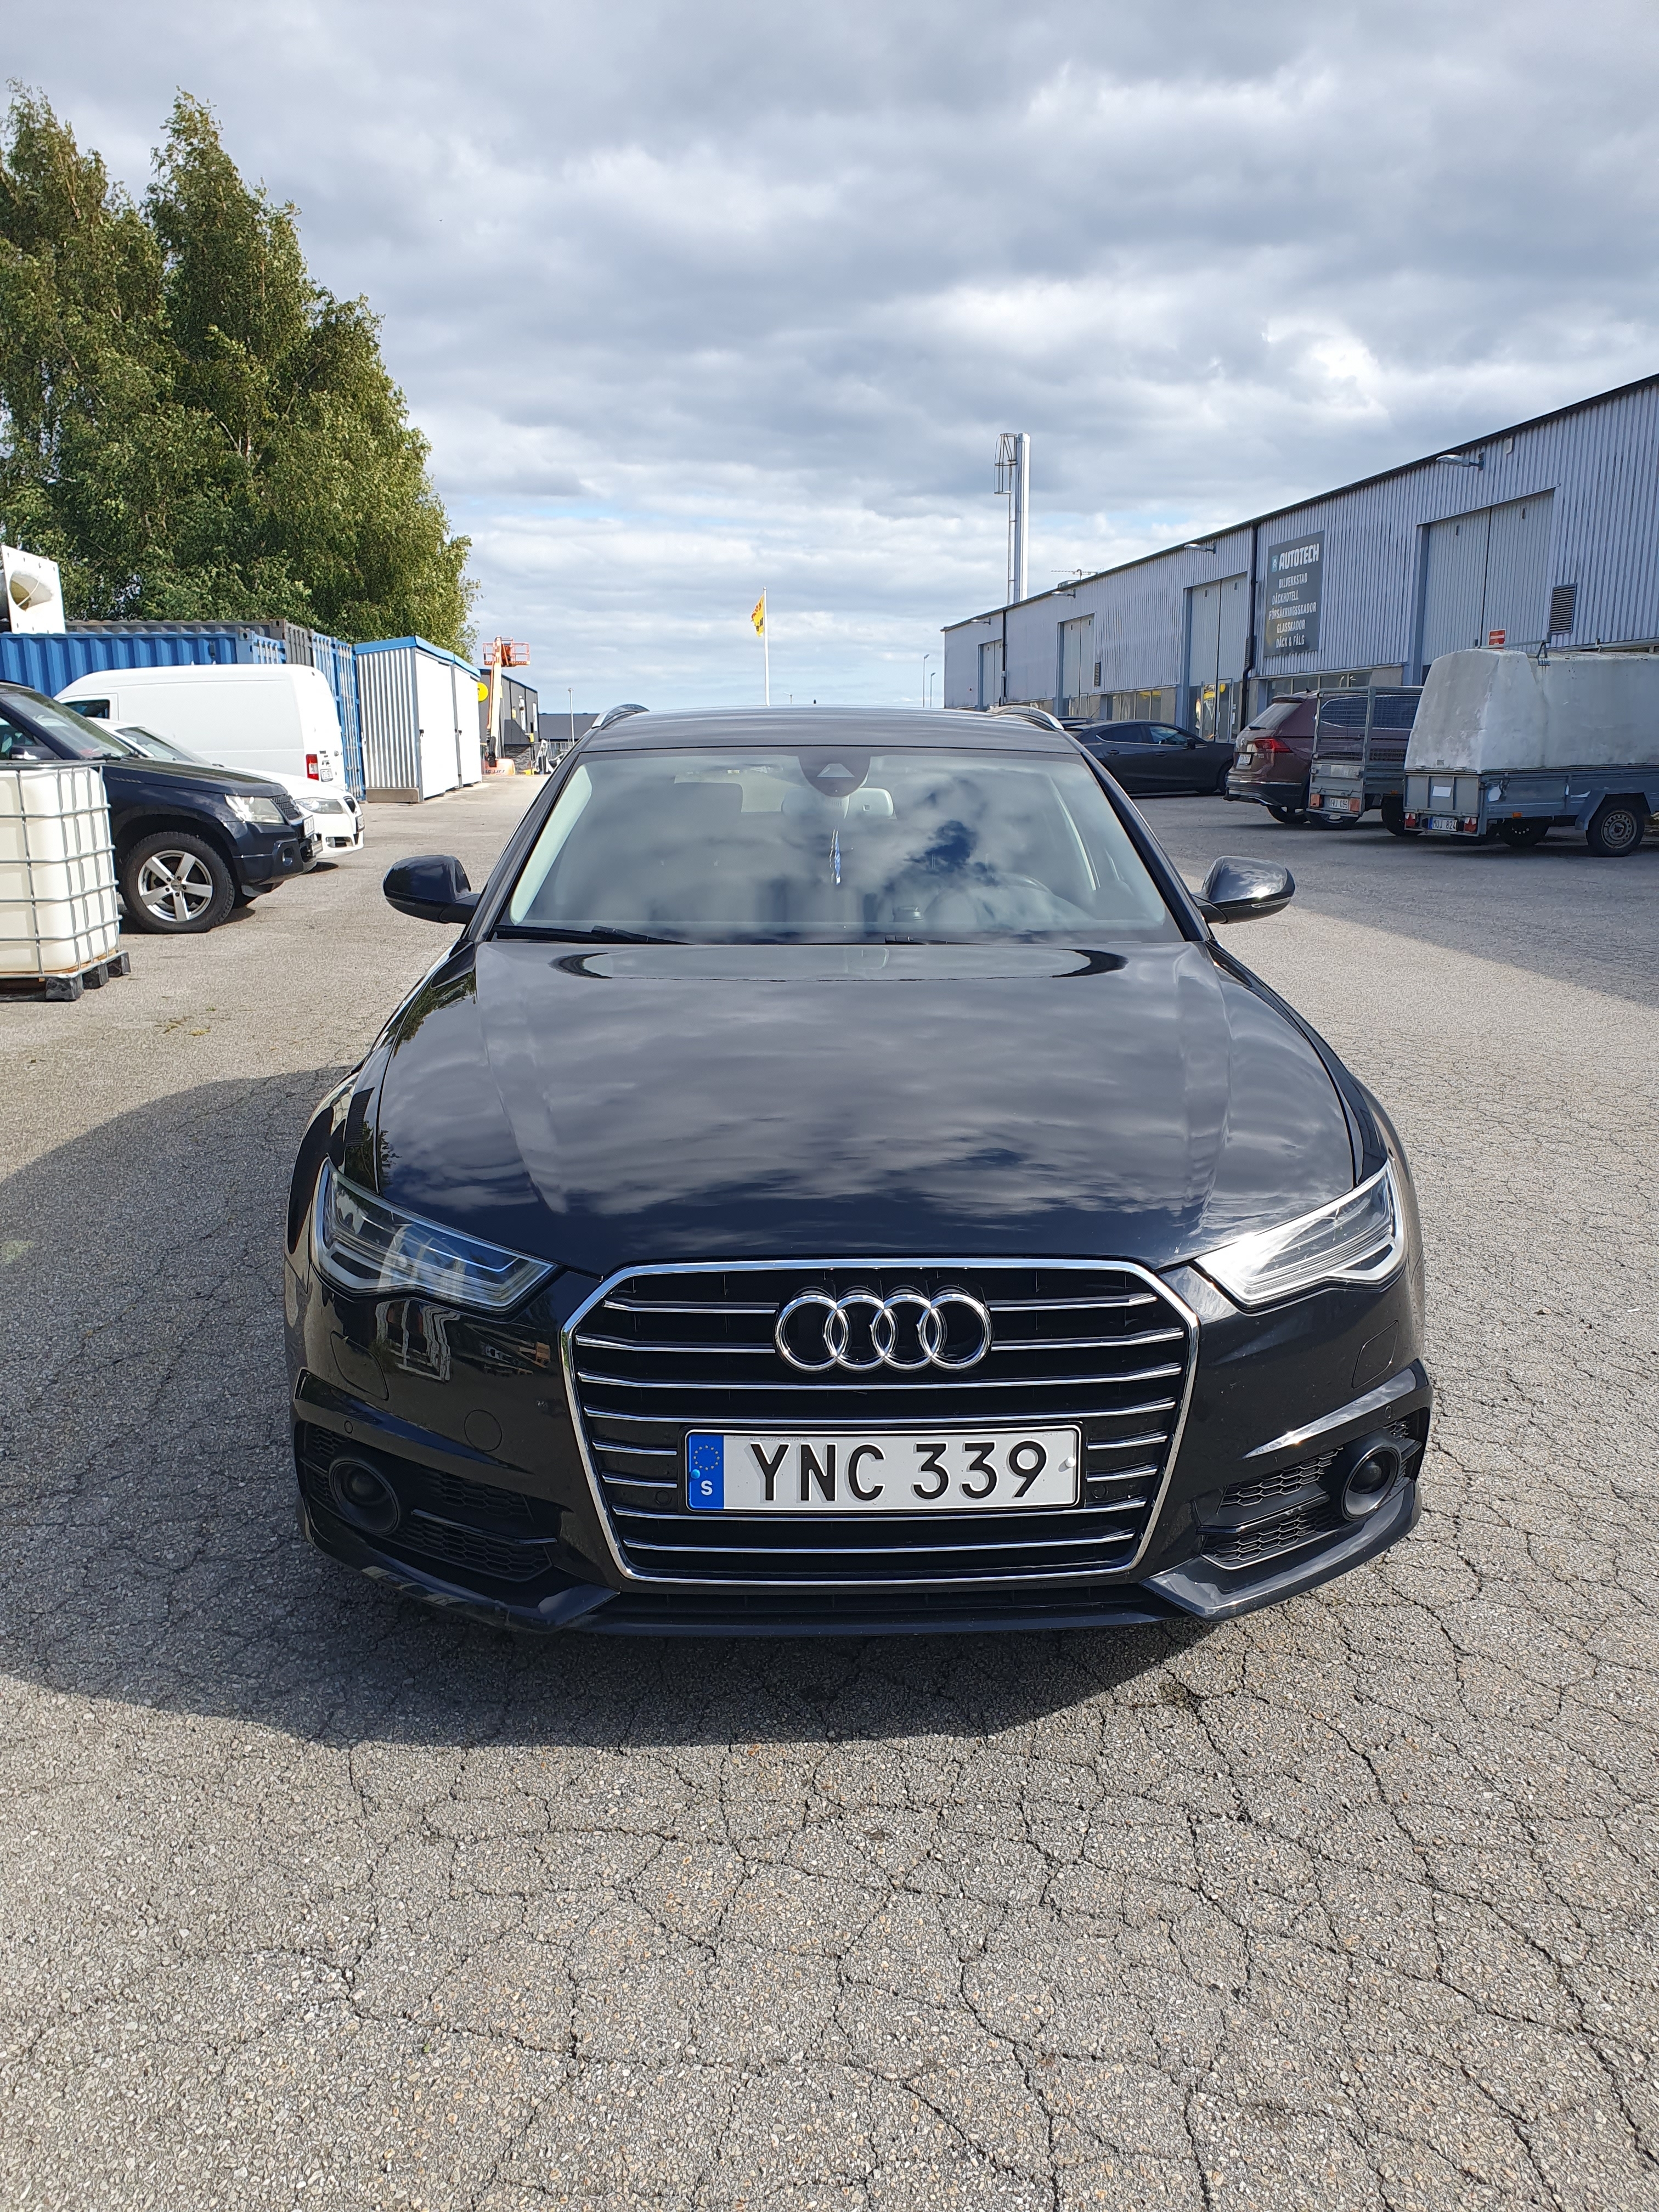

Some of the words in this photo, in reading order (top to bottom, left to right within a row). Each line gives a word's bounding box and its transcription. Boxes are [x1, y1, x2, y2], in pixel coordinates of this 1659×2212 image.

[1279, 543, 1319, 571] AUTOTECH
[1279, 572, 1308, 589] BILVERKSTAD
[1272, 590, 1299, 605] DÄCKHOTELL
[1277, 619, 1306, 634] GLASSKADOR
[1289, 636, 1292, 647] &
[750, 1442, 884, 1502] YNC
[913, 1441, 1047, 1500] 339
[701, 1480, 713, 1496] S
